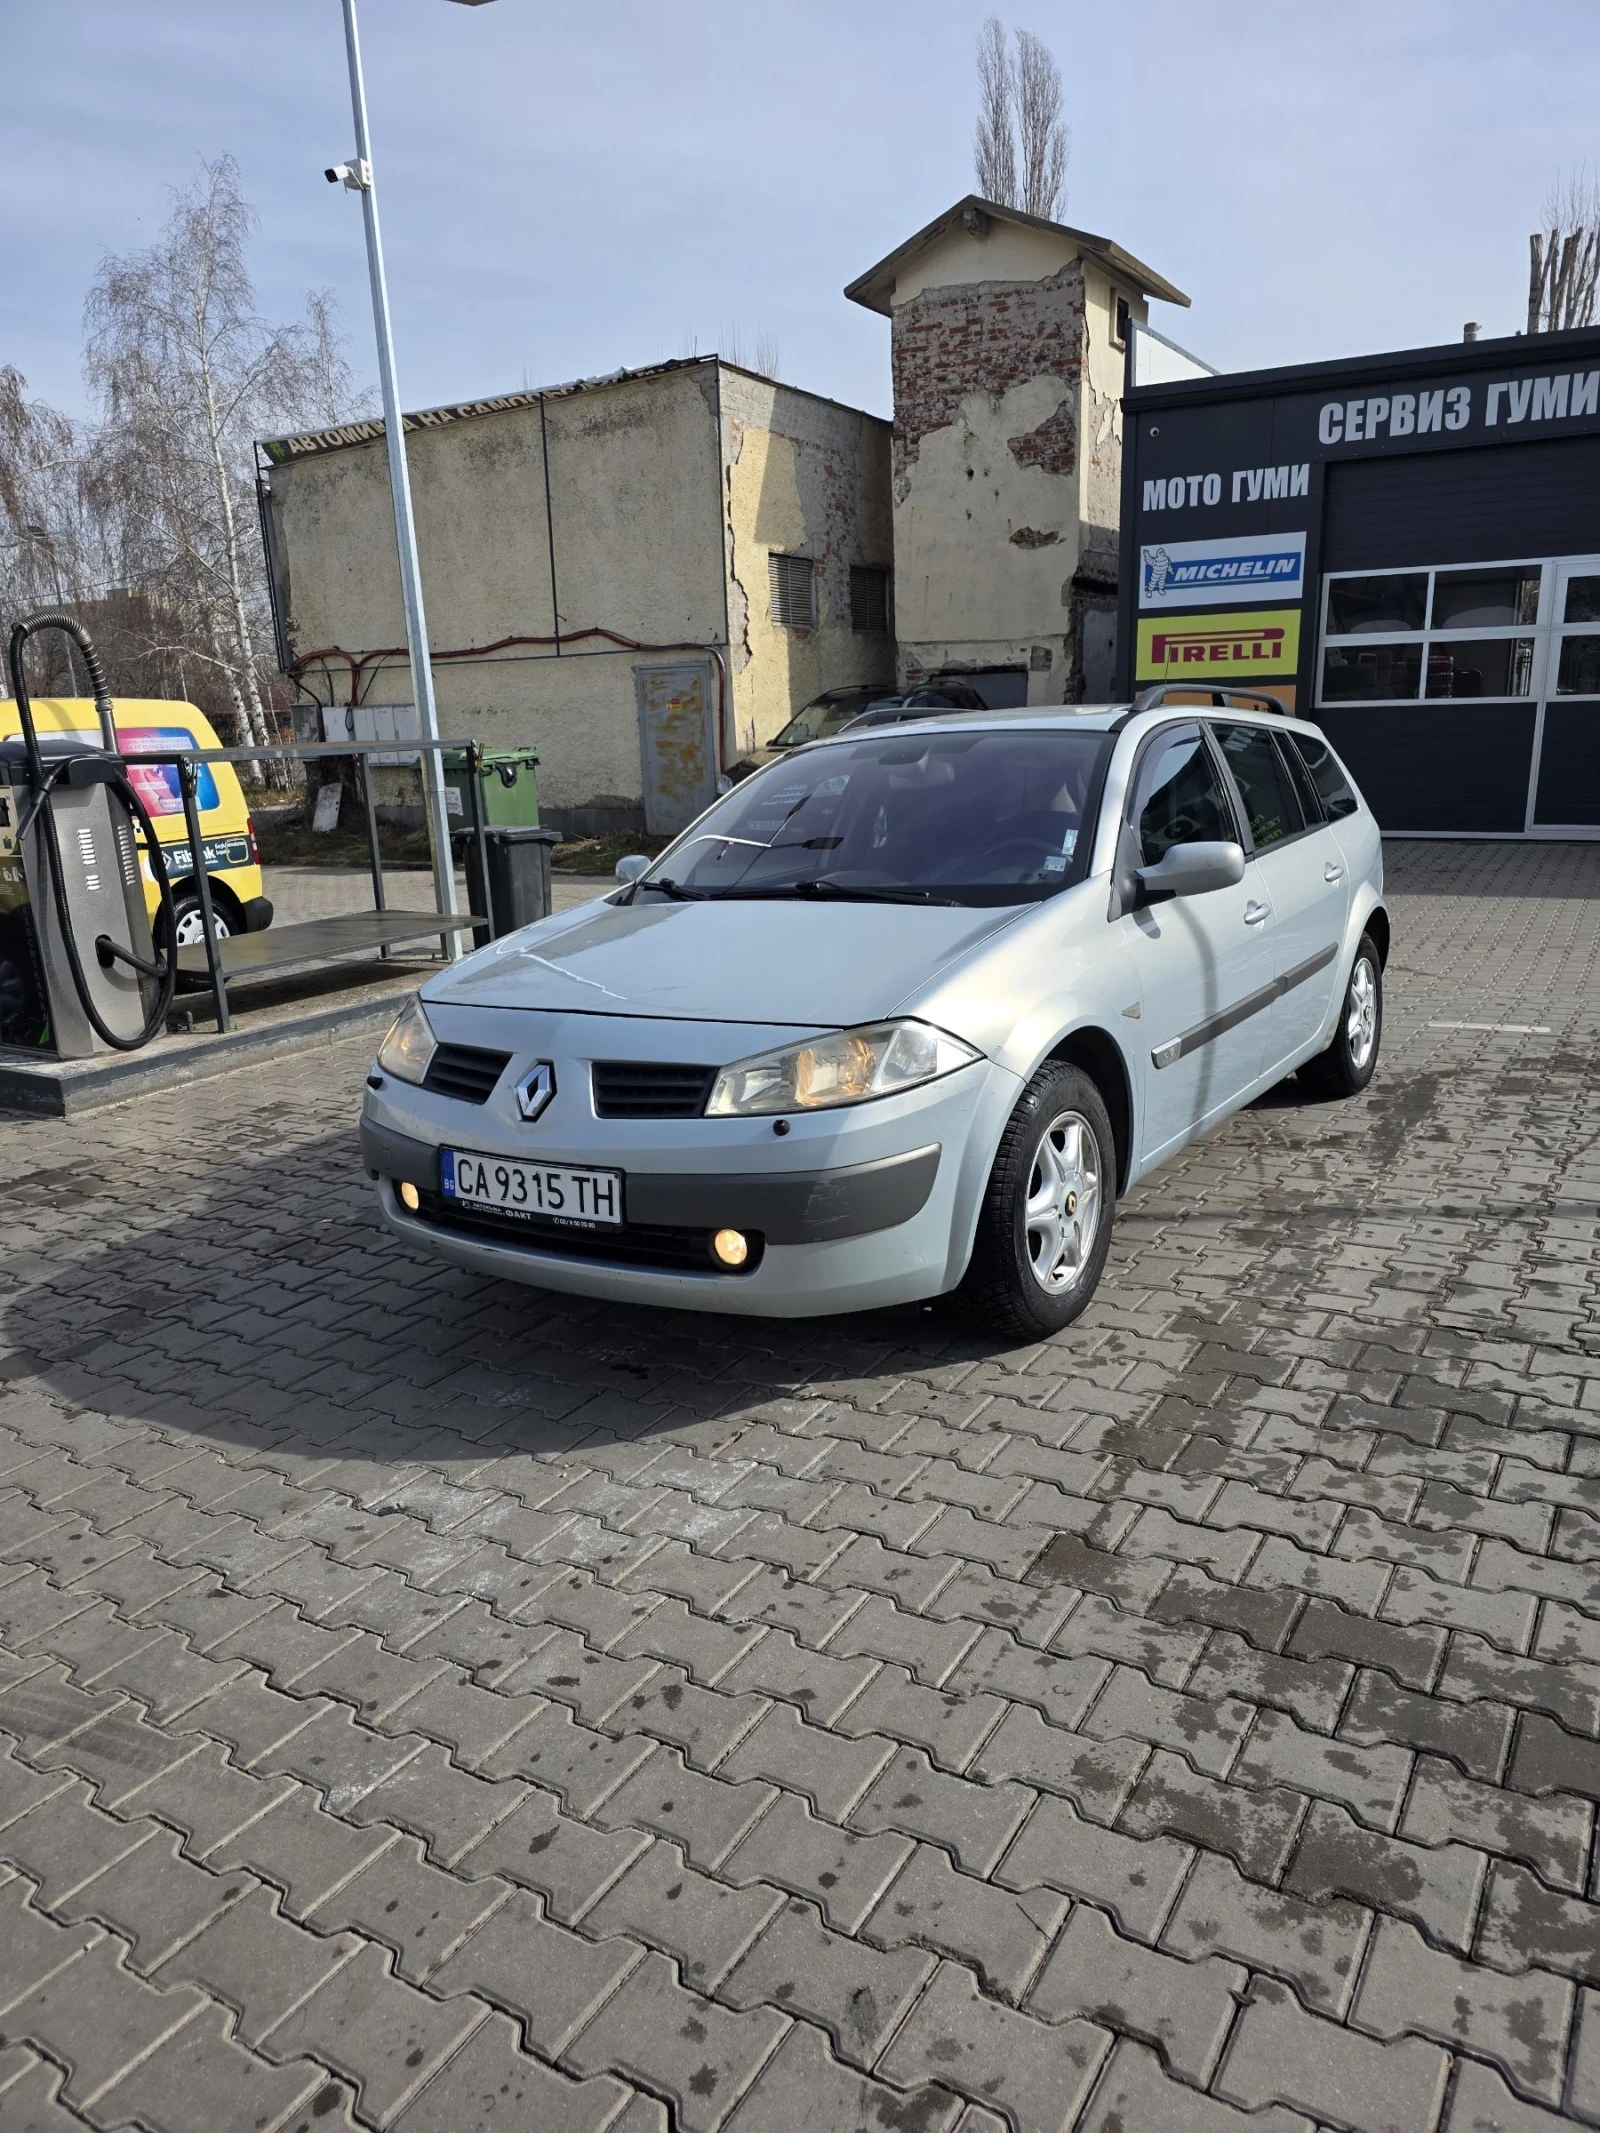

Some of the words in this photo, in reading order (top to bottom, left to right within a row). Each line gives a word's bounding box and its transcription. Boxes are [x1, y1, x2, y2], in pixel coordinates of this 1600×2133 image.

[1319, 386, 1471, 445] СЕРВИЗ
[1485, 370, 1600, 427] ГУМИ
[288, 417, 418, 454] АВТОМИВА
[418, 410, 455, 427] НА
[1143, 474, 1222, 511] МОТО
[1232, 463, 1310, 503] ГУМИ
[1174, 559, 1296, 581] MICHELIN
[1152, 628, 1285, 664] PIRELLI
[444, 1178, 455, 1190] BG
[457, 1158, 490, 1199] CA
[495, 1165, 565, 1210] 9315
[571, 1175, 614, 1217] TH
[505, 1209, 531, 1220] ФАКТ
